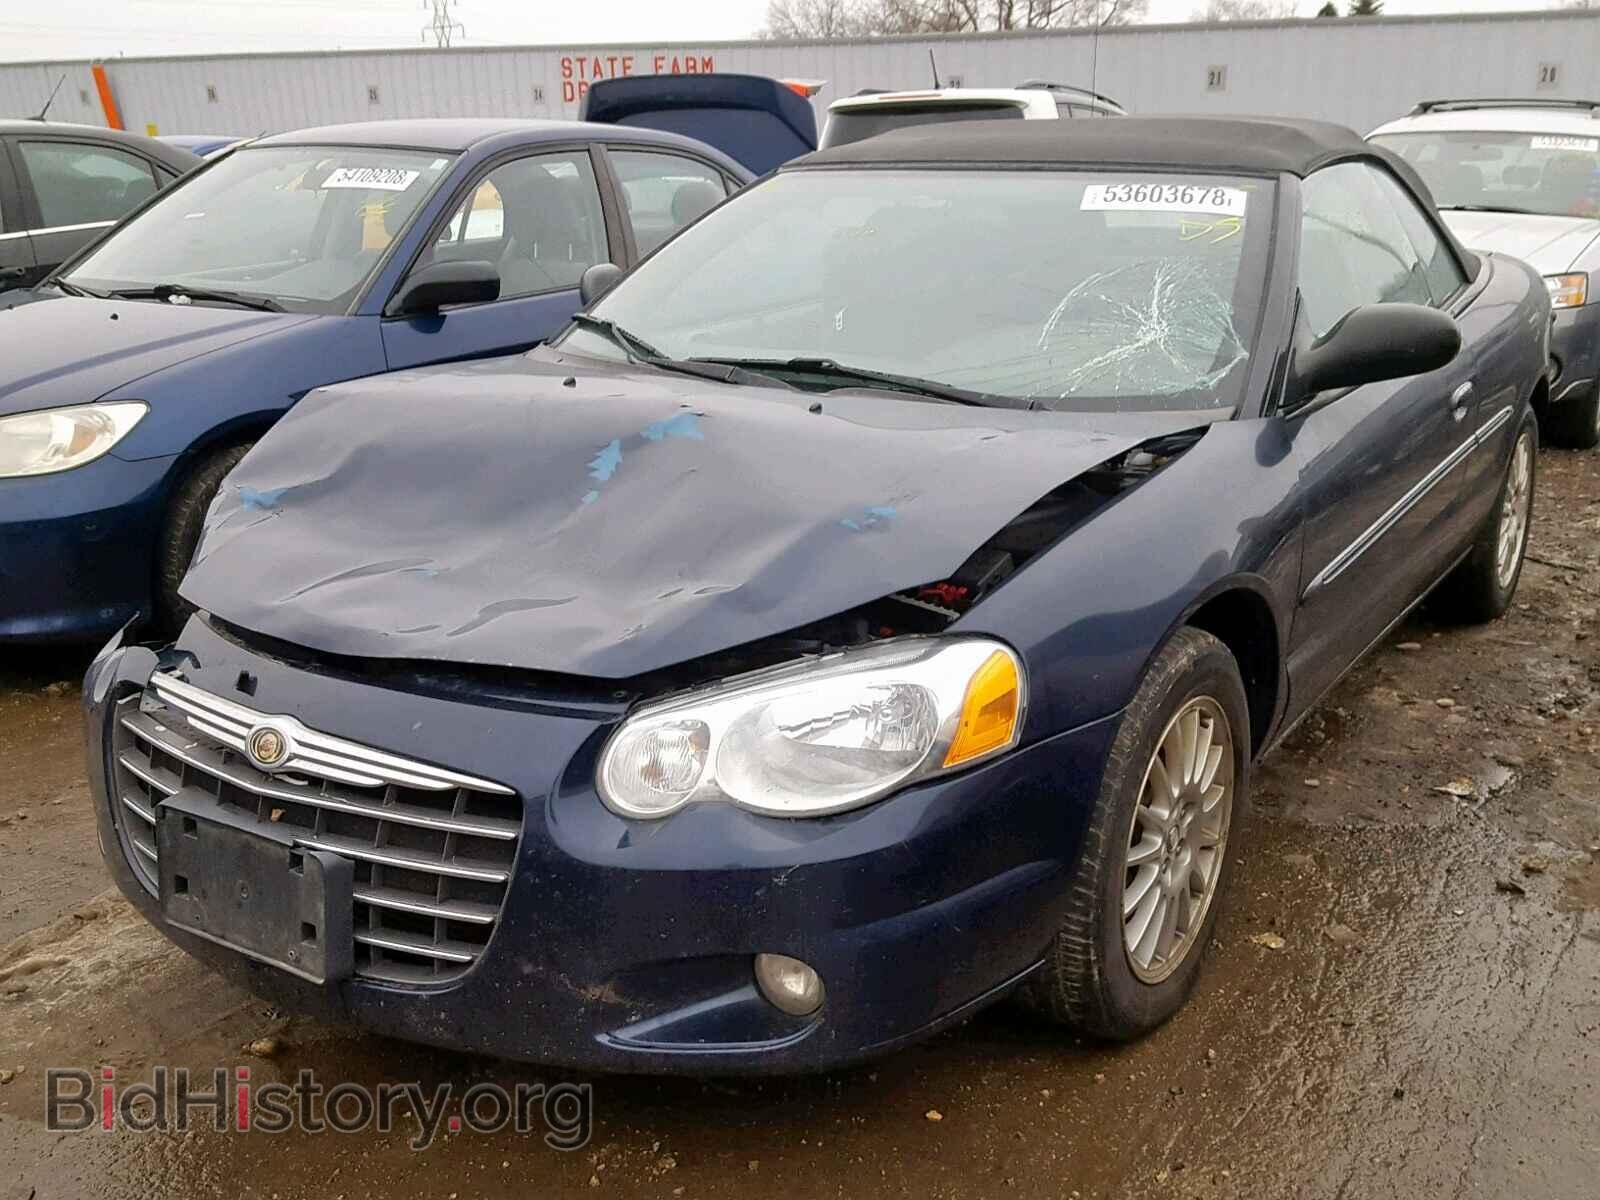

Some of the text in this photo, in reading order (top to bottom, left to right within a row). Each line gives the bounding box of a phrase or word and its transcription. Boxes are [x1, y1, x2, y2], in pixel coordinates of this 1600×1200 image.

[561, 56, 713, 80] STATE FARM
[1103, 184, 1226, 207] 53603678
